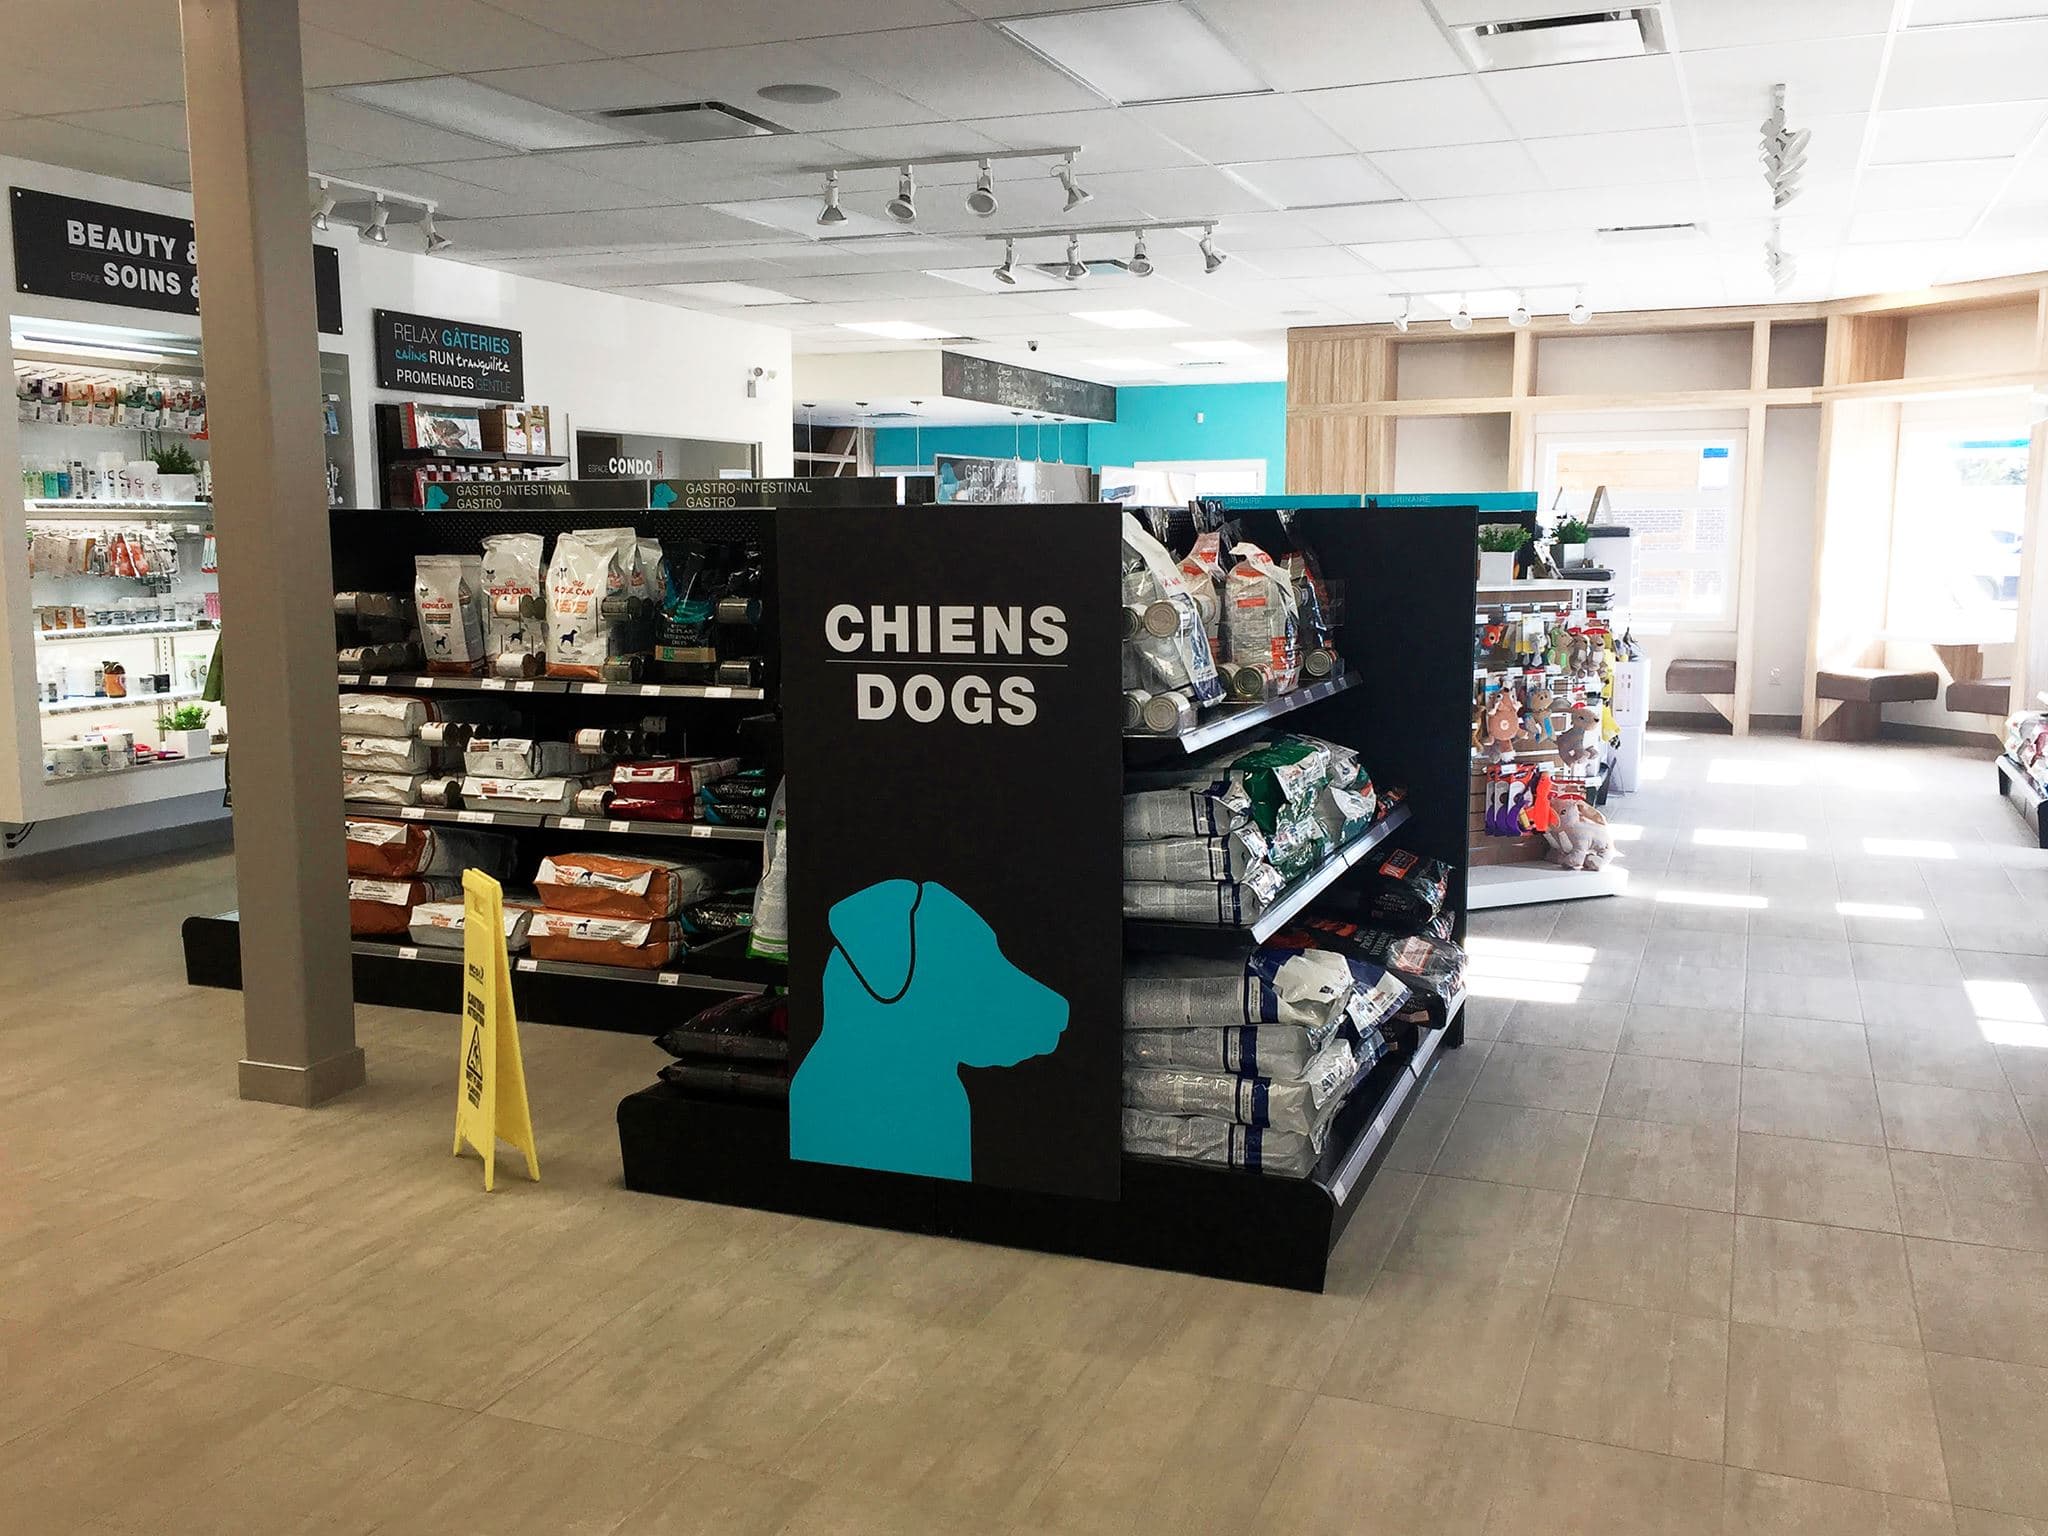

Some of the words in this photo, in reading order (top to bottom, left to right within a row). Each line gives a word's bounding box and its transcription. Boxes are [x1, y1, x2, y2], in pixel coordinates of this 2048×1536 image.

[66, 219, 176, 260] BEAUTY
[103, 262, 182, 295] SOINS
[394, 322, 438, 345] RELAX
[441, 327, 510, 355] GÂTERIES
[429, 350, 454, 366] RUN
[396, 368, 474, 390] PROMENADES
[475, 377, 512, 394] GENTLE
[608, 457, 653, 476] CONDO
[456, 484, 571, 496] GASTRO-INTESTINAL
[685, 482, 812, 494] GASTRO-INTESTINAL
[456, 498, 502, 509] GASTRO
[685, 496, 736, 508] GASTRO
[824, 603, 1069, 657] CHIENS
[856, 673, 1038, 726] DOGS
